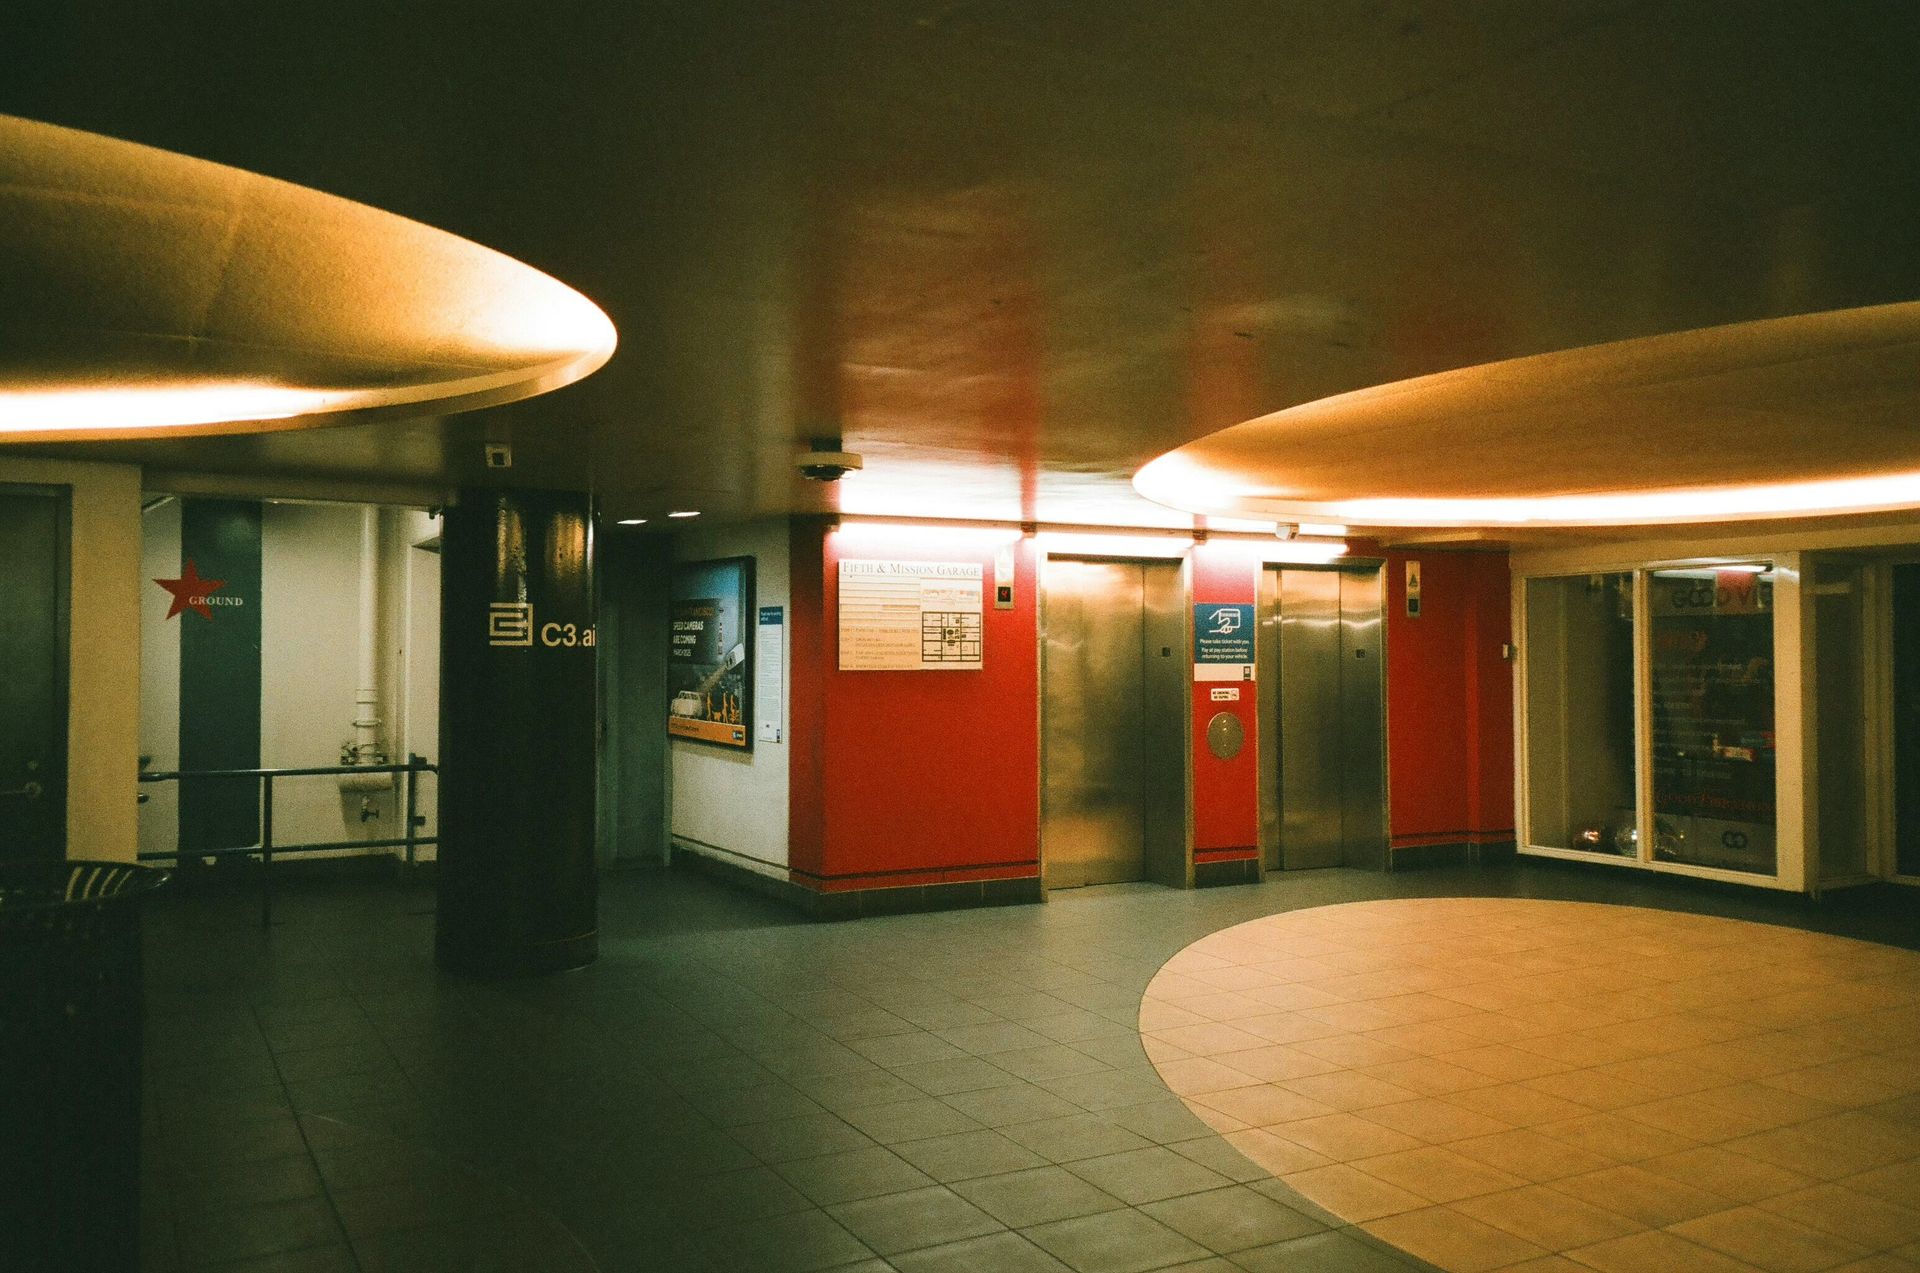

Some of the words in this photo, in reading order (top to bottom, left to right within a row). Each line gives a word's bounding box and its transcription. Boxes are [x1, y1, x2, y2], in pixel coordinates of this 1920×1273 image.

[843, 561, 874, 573] FIFTH
[876, 563, 885, 573] &
[889, 562, 934, 575] MISSION
[936, 565, 980, 577] GARAGE
[189, 596, 244, 606] GROUND
[684, 621, 704, 631] CAMERAS
[541, 623, 596, 647] C3.ai
